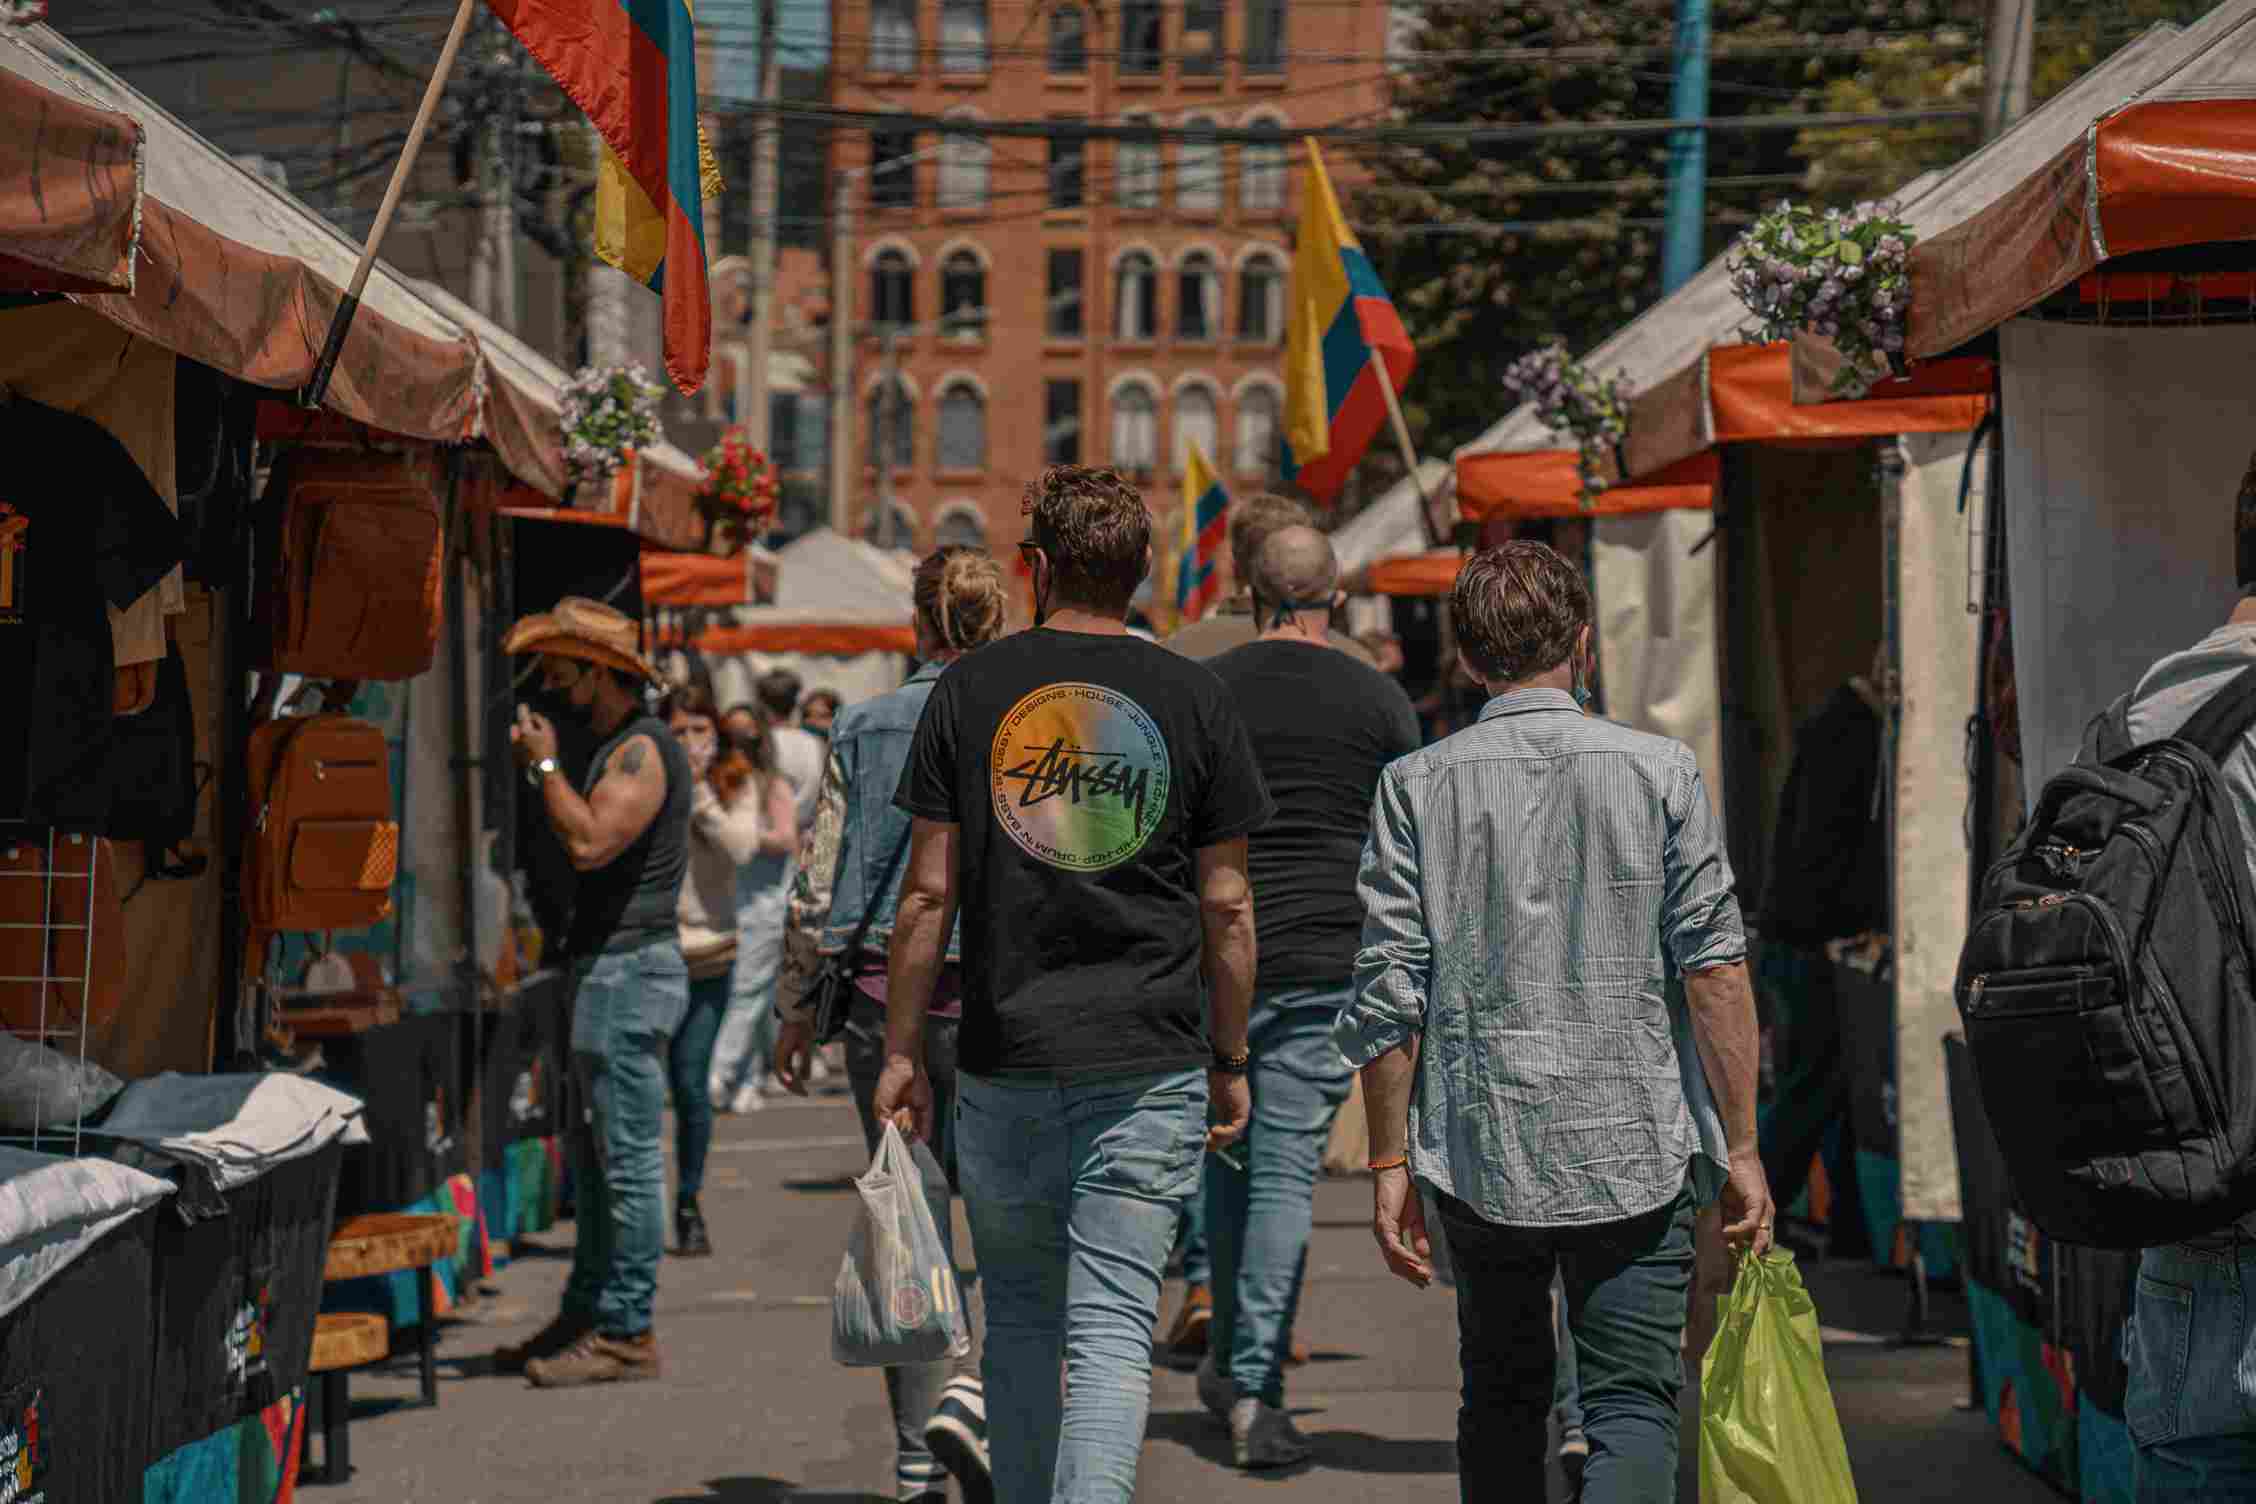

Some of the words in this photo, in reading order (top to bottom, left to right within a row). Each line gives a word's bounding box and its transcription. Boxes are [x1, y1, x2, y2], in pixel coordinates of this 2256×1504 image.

[1012, 690, 1066, 727] DESIGNS
[1074, 689, 1122, 711] HOUSE
[1128, 711, 1161, 761] JUNGLE
[998, 792, 1022, 831] BASS
[1034, 841, 1079, 864] DRUM
